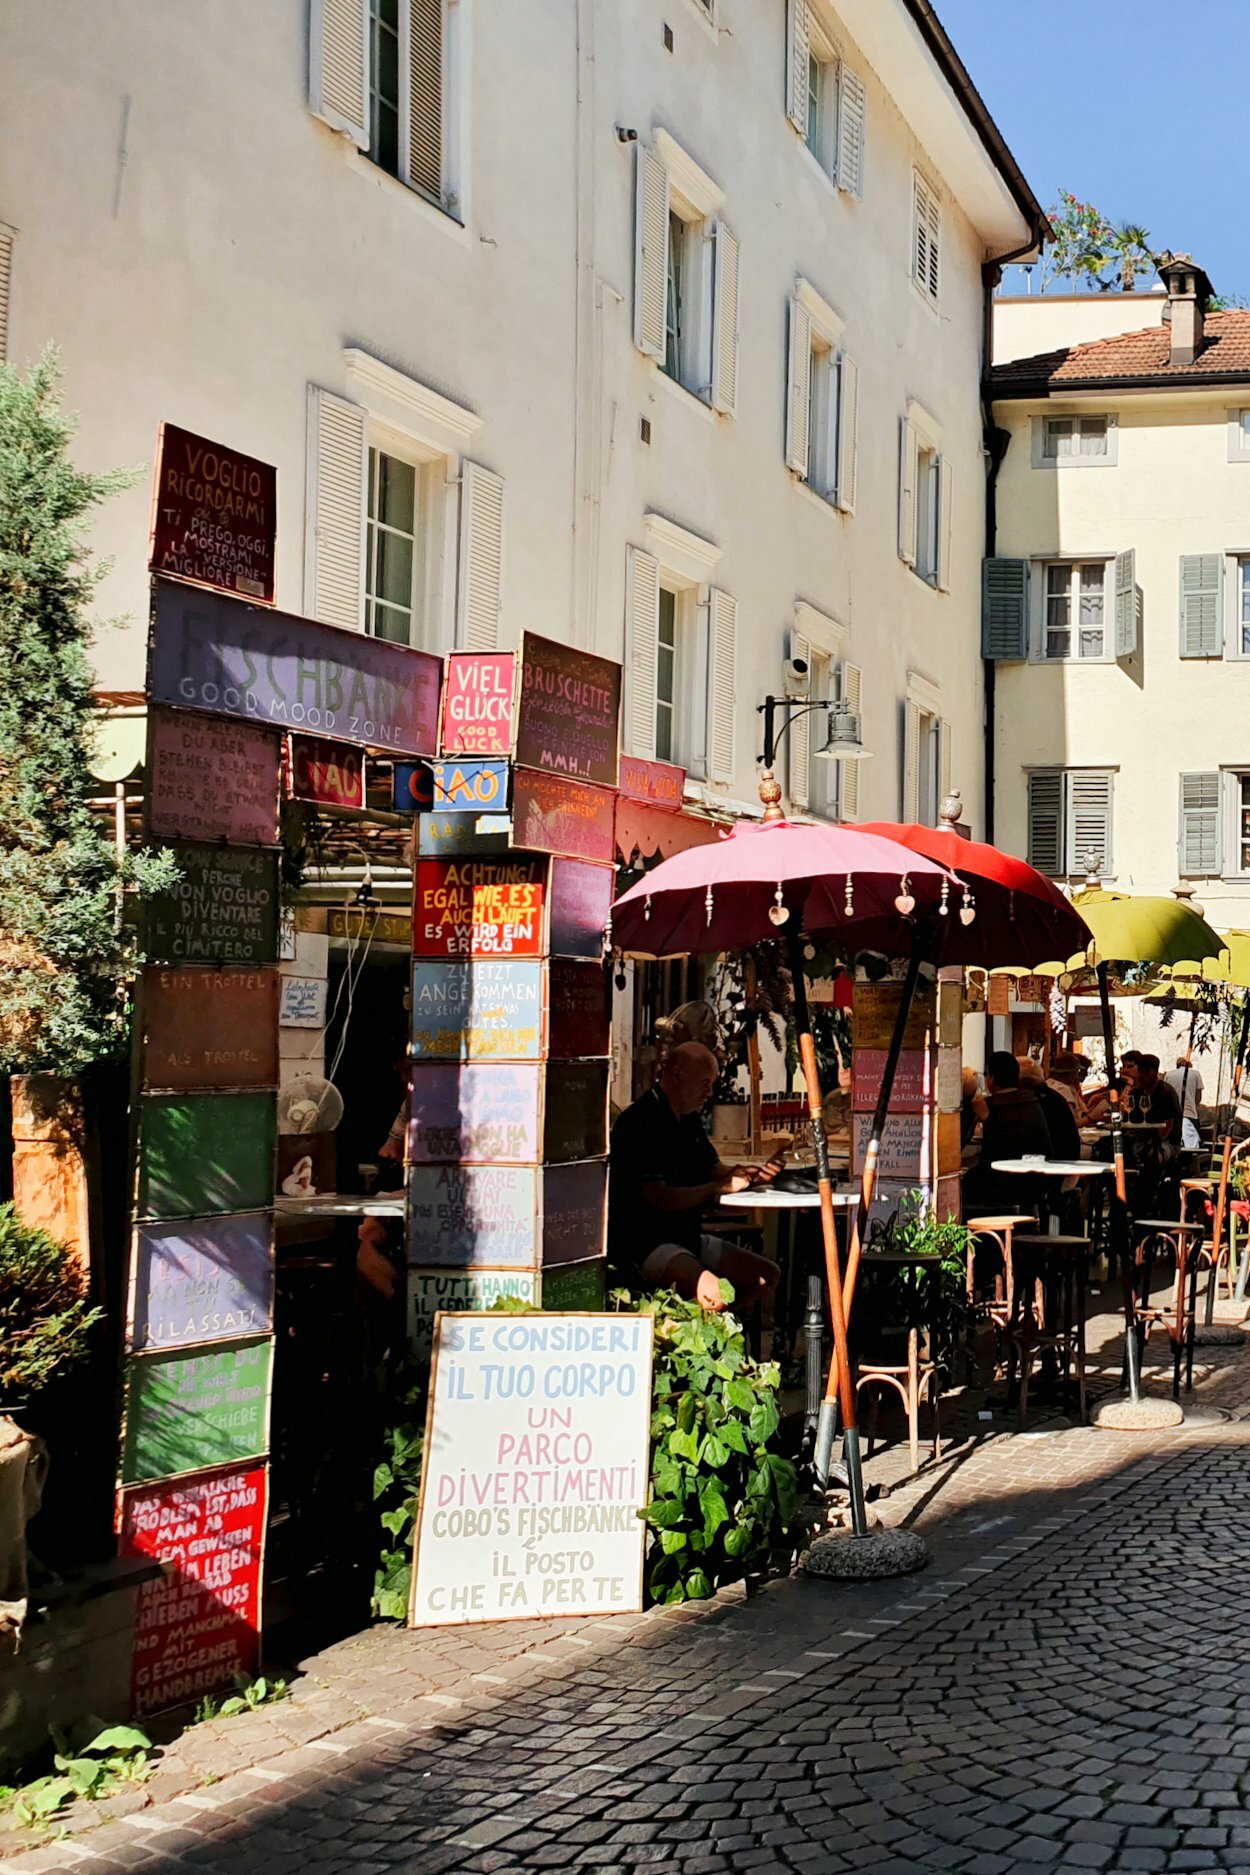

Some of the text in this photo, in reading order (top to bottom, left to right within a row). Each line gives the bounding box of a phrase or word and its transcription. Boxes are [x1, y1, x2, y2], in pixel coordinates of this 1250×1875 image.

[171, 541, 188, 556] LA
[523, 662, 611, 714] BRUSCHETTE
[178, 676, 258, 712] GOOD
[269, 701, 335, 729] MOOD
[349, 716, 402, 744] ZONE
[450, 690, 510, 721] GLÜCK
[182, 733, 204, 749] DU
[453, 737, 503, 750] LUCK
[457, 726, 497, 736] GOOD
[443, 861, 535, 885] ACHTUNG!
[423, 887, 468, 909] EGAL
[509, 885, 535, 907] ES
[440, 907, 485, 925] AUCH
[242, 928, 263, 941] DEL
[424, 923, 443, 939] ES
[447, 937, 513, 953] ERFOLG
[481, 1277, 531, 1297] HANNO
[448, 1325, 485, 1353] SE
[479, 1363, 536, 1400] TUO
[544, 1362, 636, 1399] CORPO
[527, 1406, 572, 1429] UN
[497, 1432, 593, 1466] PARCO
[155, 1514, 223, 1545] MAN AB
[431, 1505, 511, 1538] COBO'S
[204, 1544, 252, 1579] LEBEN
[524, 1549, 595, 1576] POSTO
[427, 1576, 624, 1612] CHE FA PER TE
[136, 1638, 239, 1686] GEZOGENER
[136, 1657, 243, 1709] HANDBREMSE
